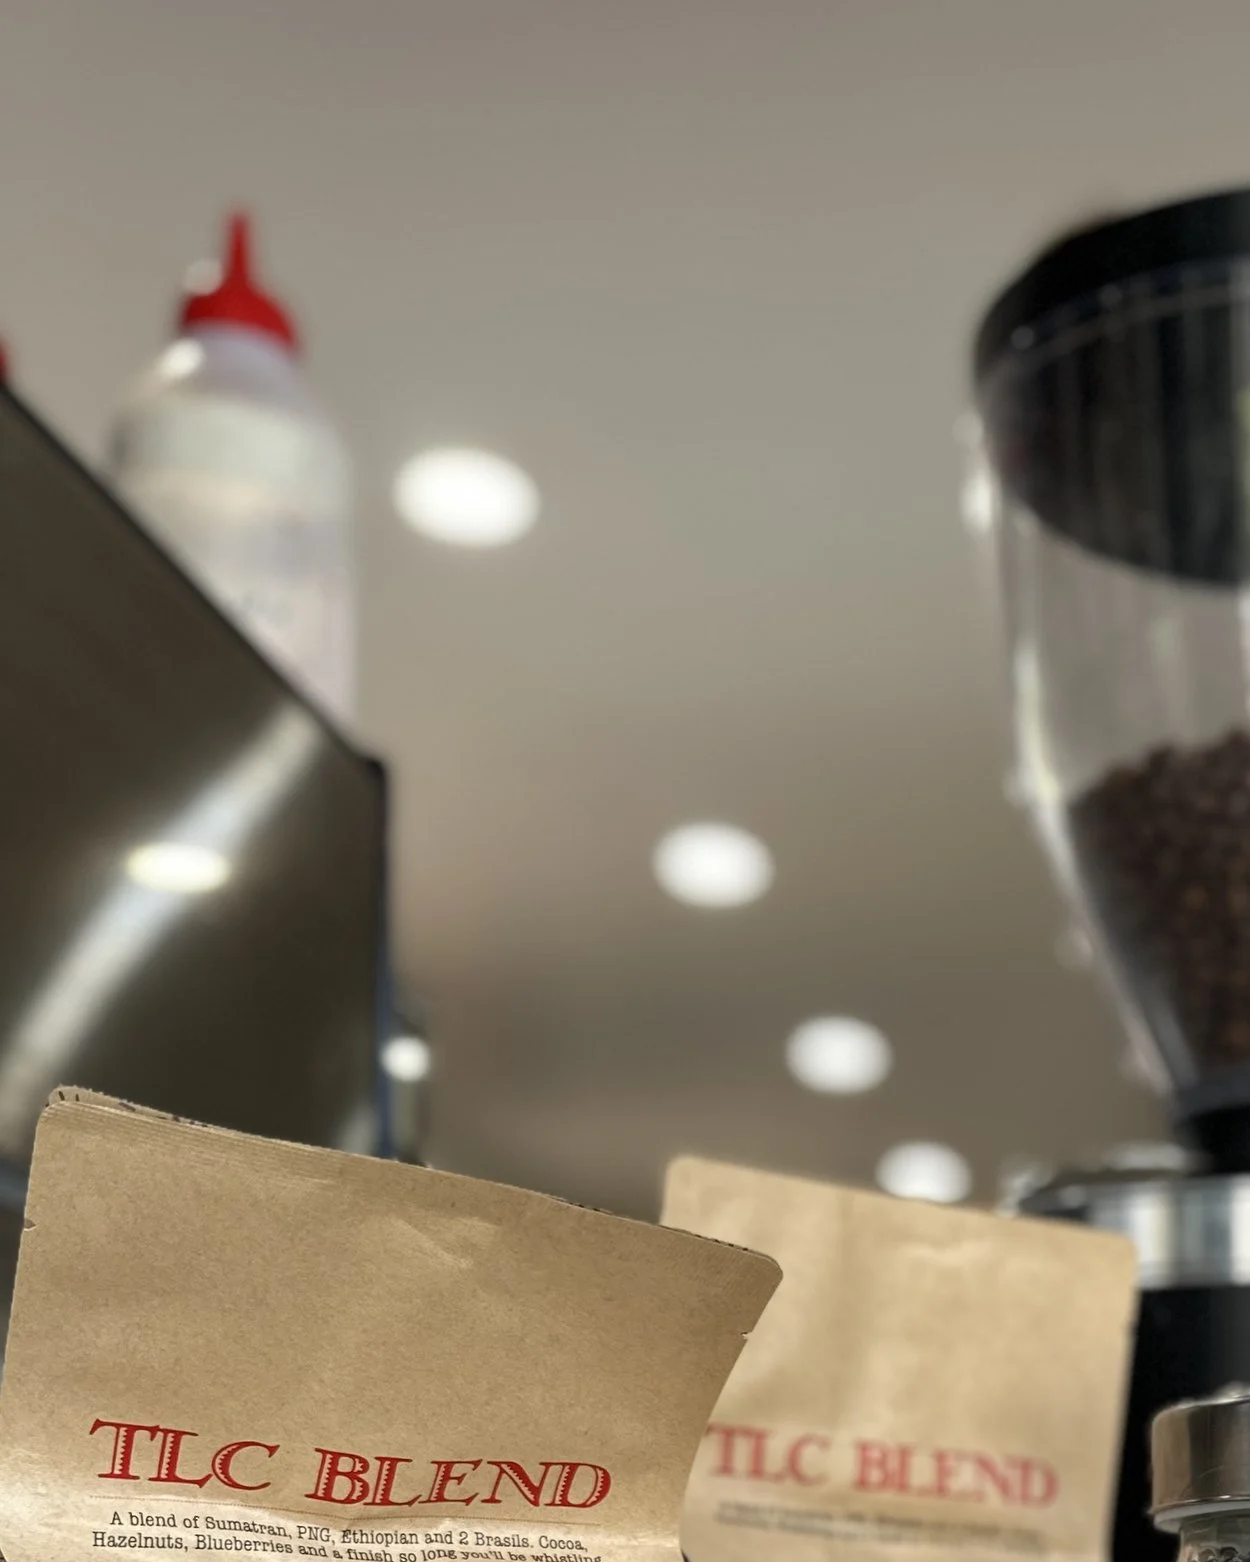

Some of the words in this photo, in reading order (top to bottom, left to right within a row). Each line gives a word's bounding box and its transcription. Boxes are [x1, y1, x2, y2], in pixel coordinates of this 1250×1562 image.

[89, 1418, 280, 1490] TLC
[304, 1447, 612, 1508] BLEND
[706, 1424, 831, 1487] TLC
[853, 1438, 1060, 1508] BLEND
[92, 1531, 189, 1552] Hazelnuts,
[195, 1534, 294, 1554] Blueberries
[299, 1543, 328, 1558] and
[333, 1550, 343, 1560] a
[423, 1549, 458, 1562] long
[508, 1551, 527, 1562] be
[110, 1511, 122, 1526] A
[129, 1512, 177, 1528] blend
[183, 1516, 200, 1529] of
[205, 1516, 293, 1540] Sumatran,
[297, 1525, 335, 1545] PNG,
[341, 1529, 420, 1547] Ethiopian
[425, 1530, 453, 1545] and
[459, 1531, 469, 1546] 2
[474, 1531, 535, 1549] Brasils.
[539, 1535, 589, 1552] Cocoa,
